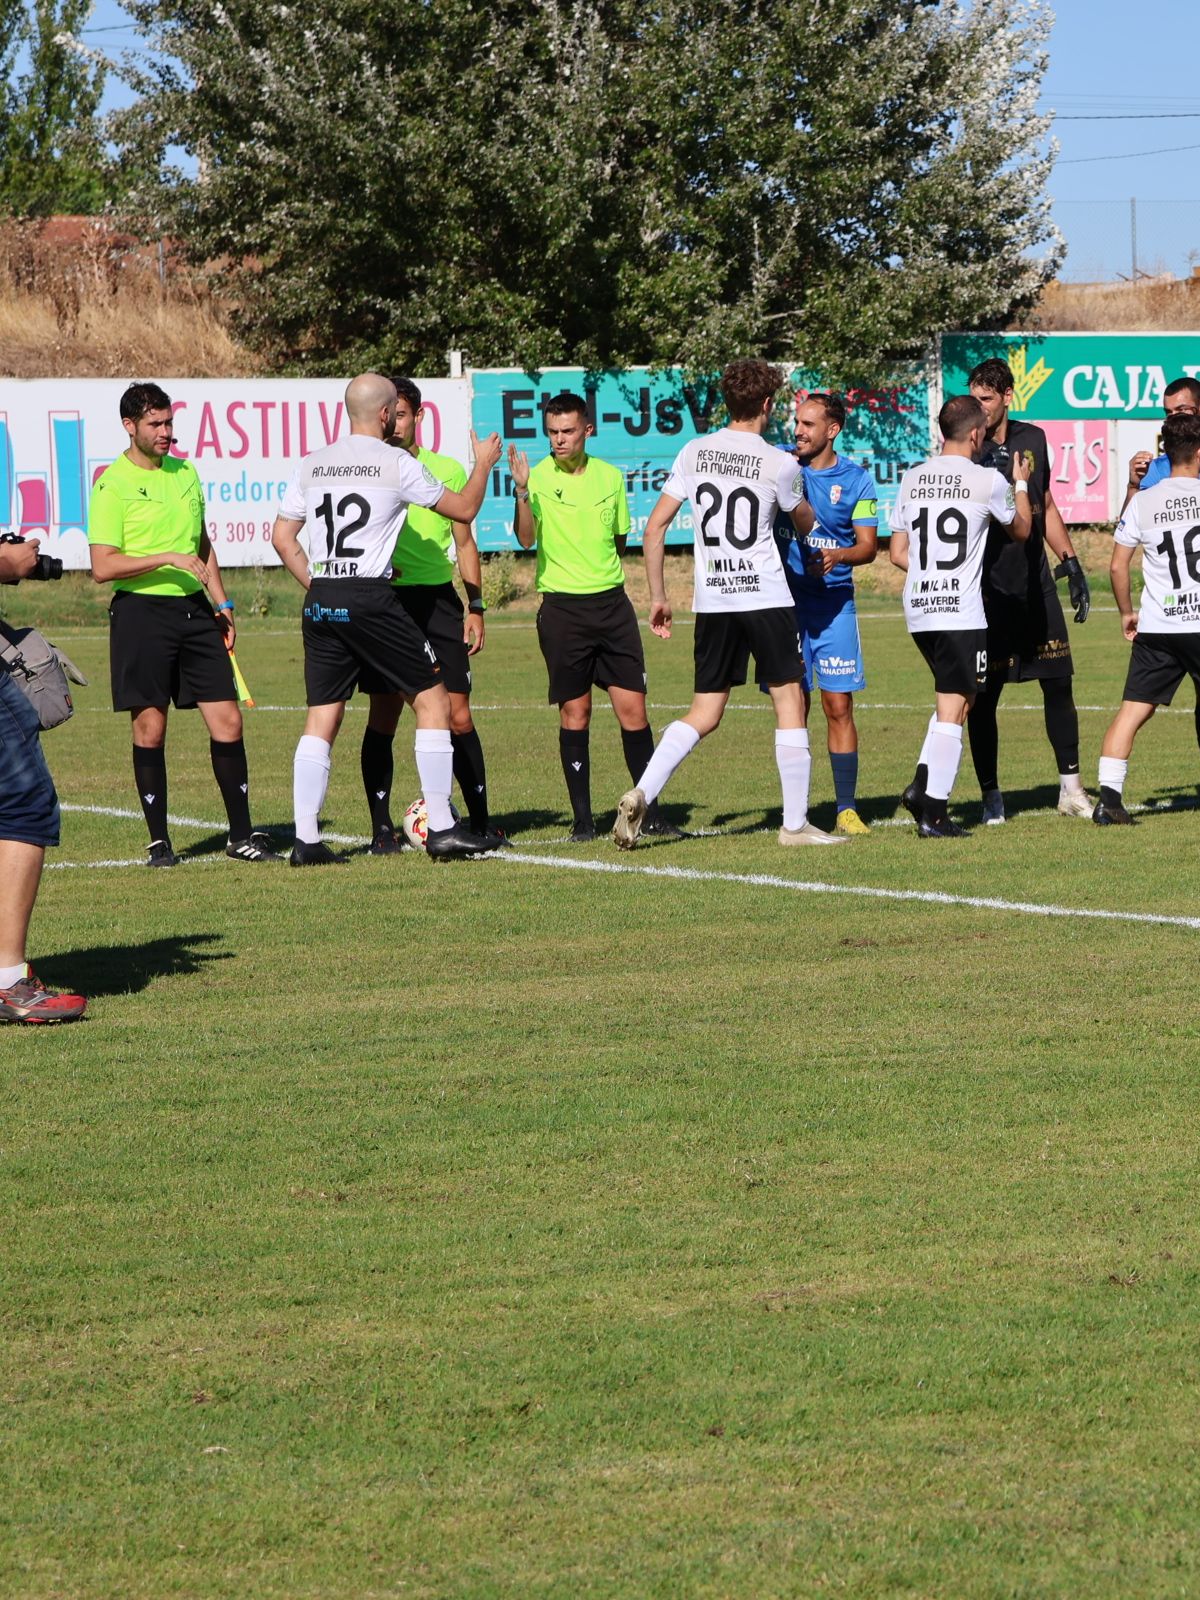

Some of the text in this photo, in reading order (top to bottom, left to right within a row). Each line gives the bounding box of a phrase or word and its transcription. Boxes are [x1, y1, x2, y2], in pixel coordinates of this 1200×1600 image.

[1063, 365, 1169, 412] CAJA
[697, 449, 763, 469] RESTAURANTE
[696, 461, 760, 480] LA MURALLA
[918, 474, 962, 485] AUTOS
[910, 484, 970, 500] CASTAÑO
[1165, 496, 1197, 510] CASA
[695, 482, 760, 551] 20
[227, 522, 255, 542] 309
[263, 522, 272, 542] 8
[314, 492, 371, 559] 12
[911, 506, 968, 571] 19
[714, 558, 755, 573] MILAR
[706, 574, 760, 587] SIEGA VERDE
[920, 578, 960, 592] MILAR
[720, 585, 761, 595] CASA RURAL
[911, 596, 960, 609] SIEGA VERDE
[923, 607, 937, 615] CASA
[1163, 605, 1189, 617] SIEGA
[1181, 614, 1200, 622] CASA
[976, 650, 988, 673] 19
